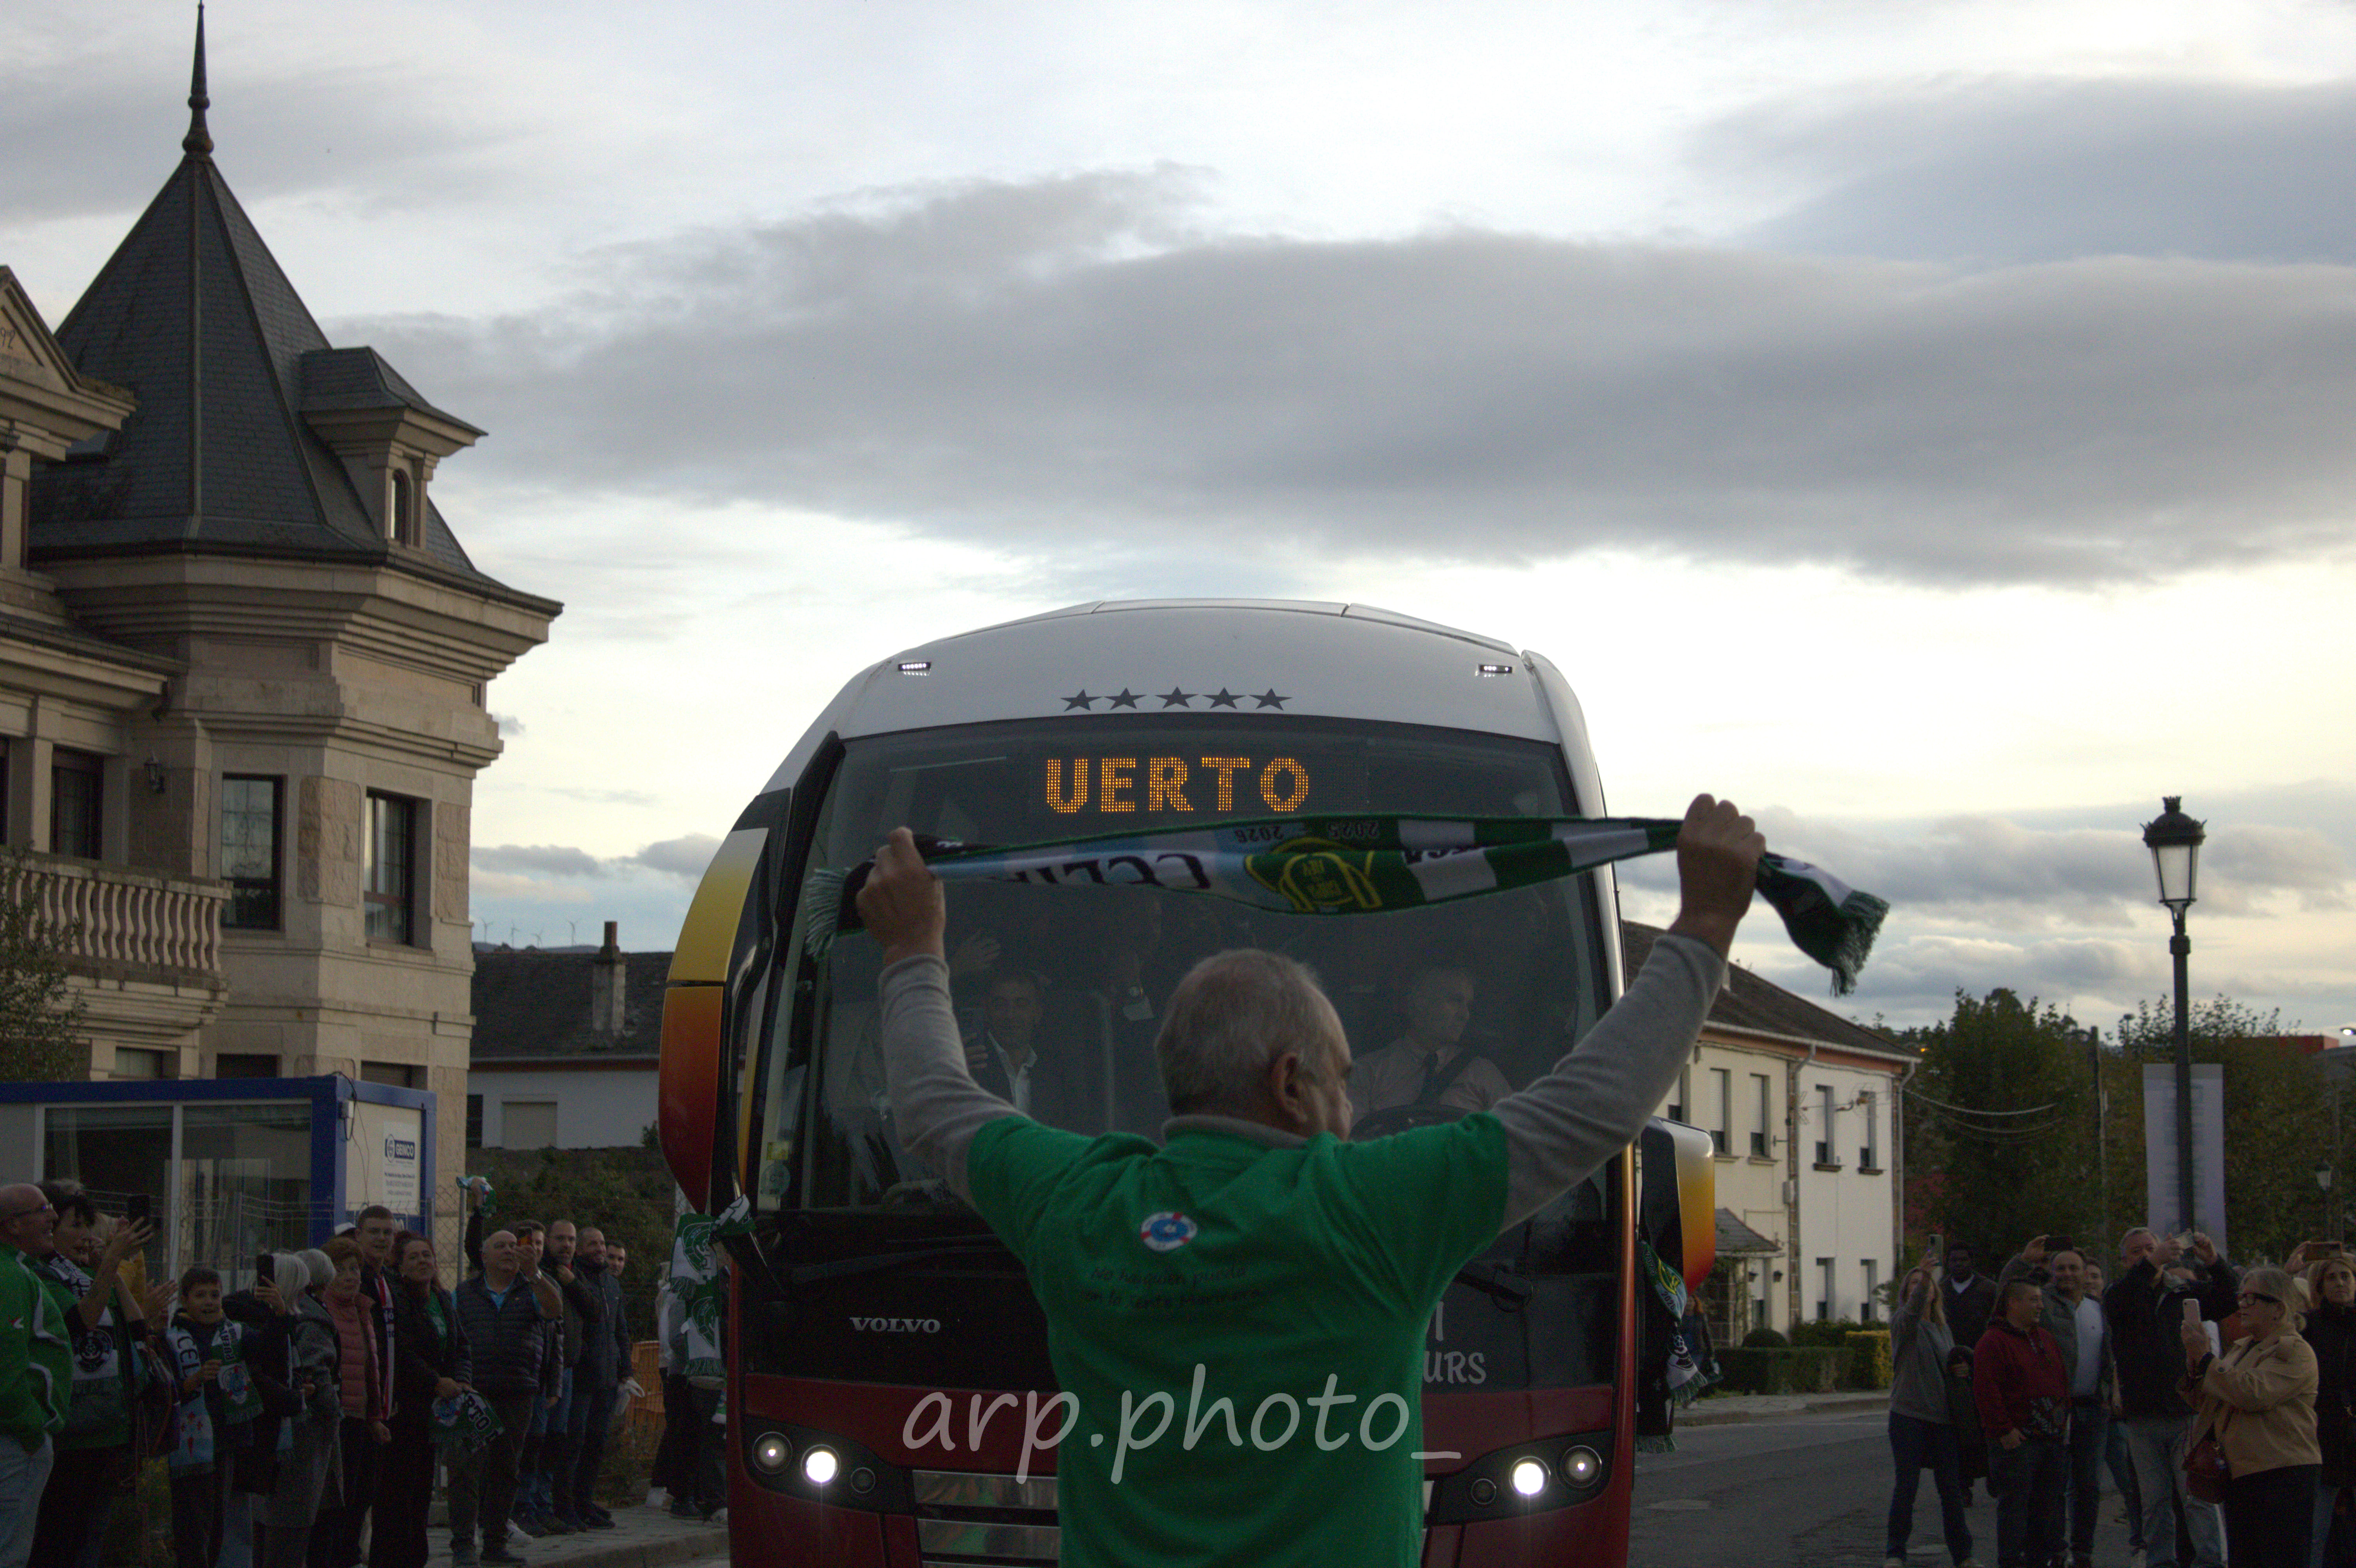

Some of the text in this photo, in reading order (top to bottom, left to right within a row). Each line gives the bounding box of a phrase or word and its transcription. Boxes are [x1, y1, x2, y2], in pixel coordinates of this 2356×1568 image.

[1047, 757, 1309, 813] UERTO
[1235, 826, 1284, 843] 2026
[1192, 1262, 1246, 1289] pueda
[850, 1317, 941, 1333] VOLVO
